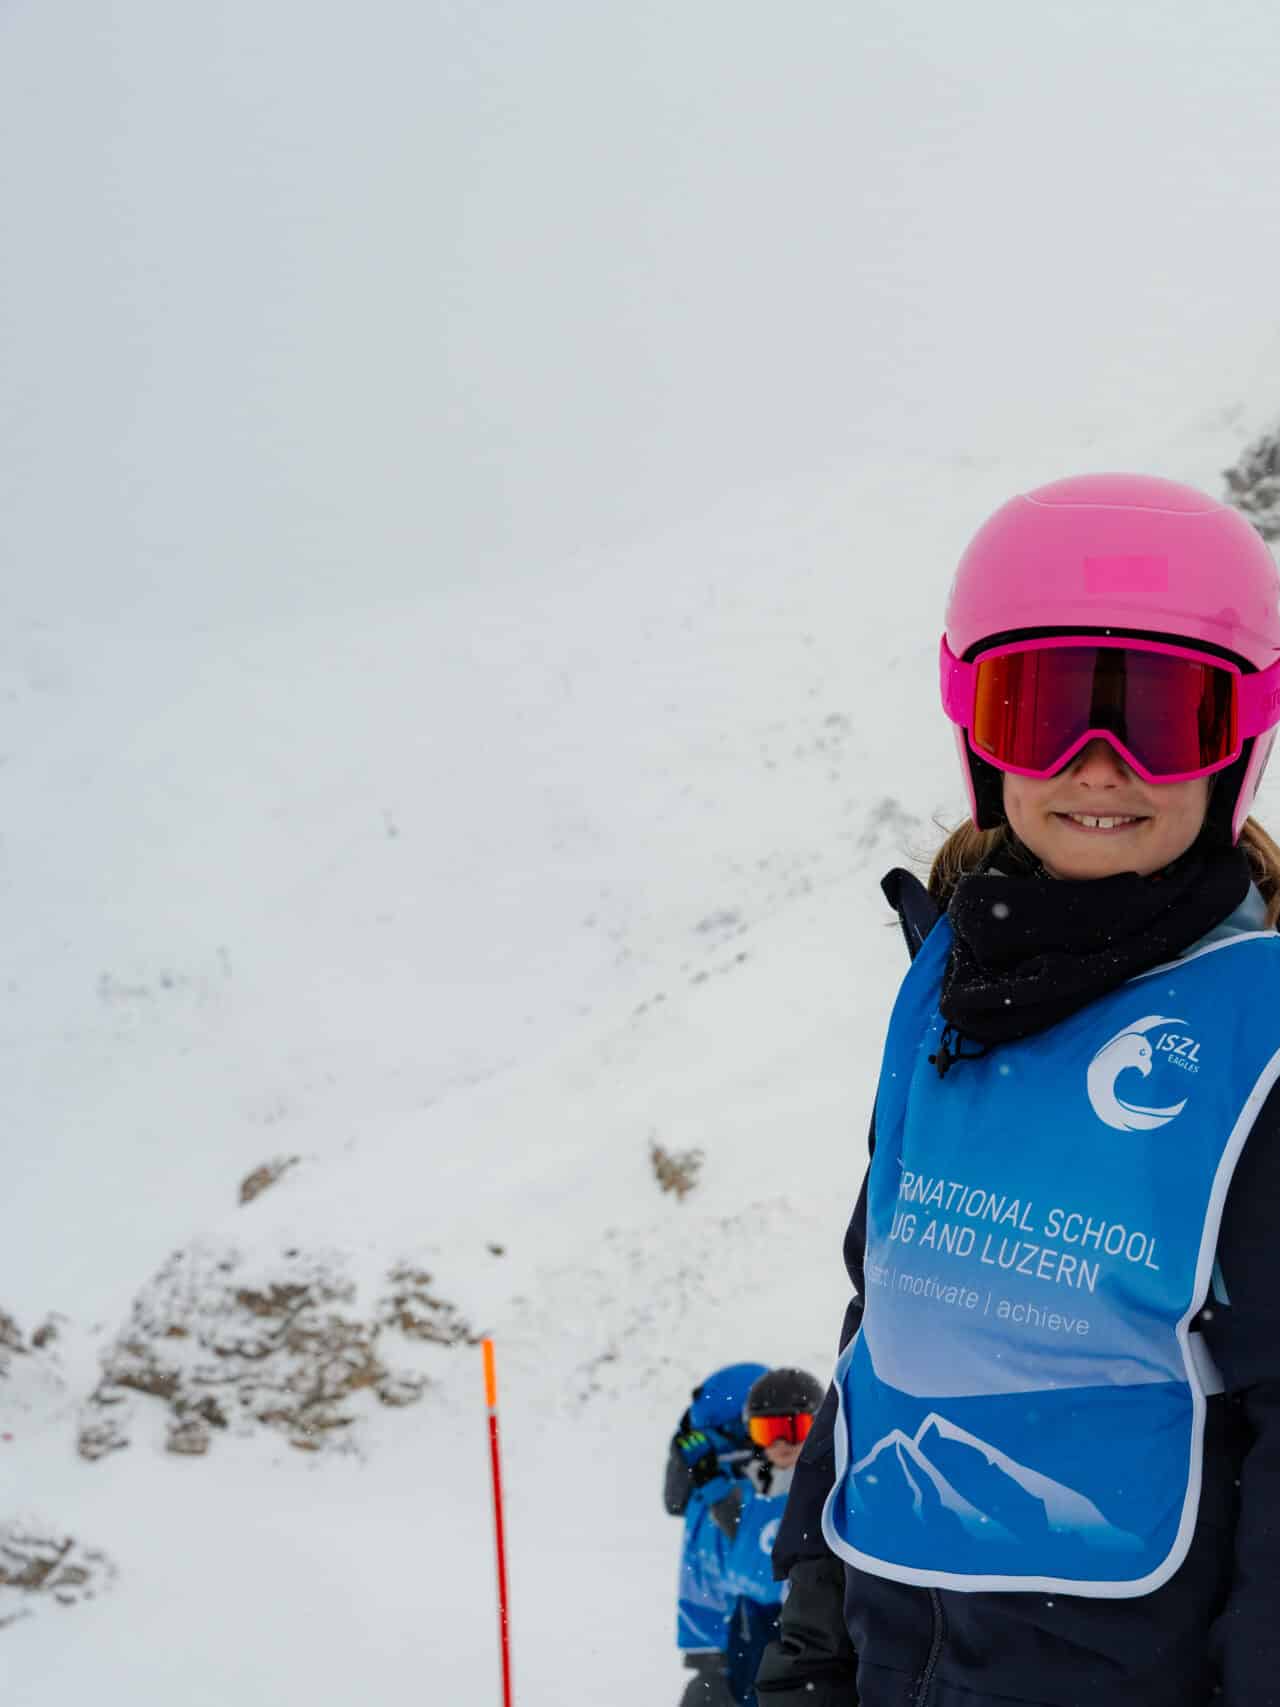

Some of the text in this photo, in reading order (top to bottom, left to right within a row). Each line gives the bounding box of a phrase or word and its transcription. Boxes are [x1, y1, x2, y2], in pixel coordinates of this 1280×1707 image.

[1155, 1033, 1201, 1063] ISZL
[1167, 1054, 1201, 1073] EAGLES
[889, 1208, 1100, 1294] UG AND LUZERN
[898, 1170, 1160, 1271] RNATIONAL SCHOOL
[899, 1271, 979, 1309] motivate
[996, 1299, 1090, 1336] achieve
